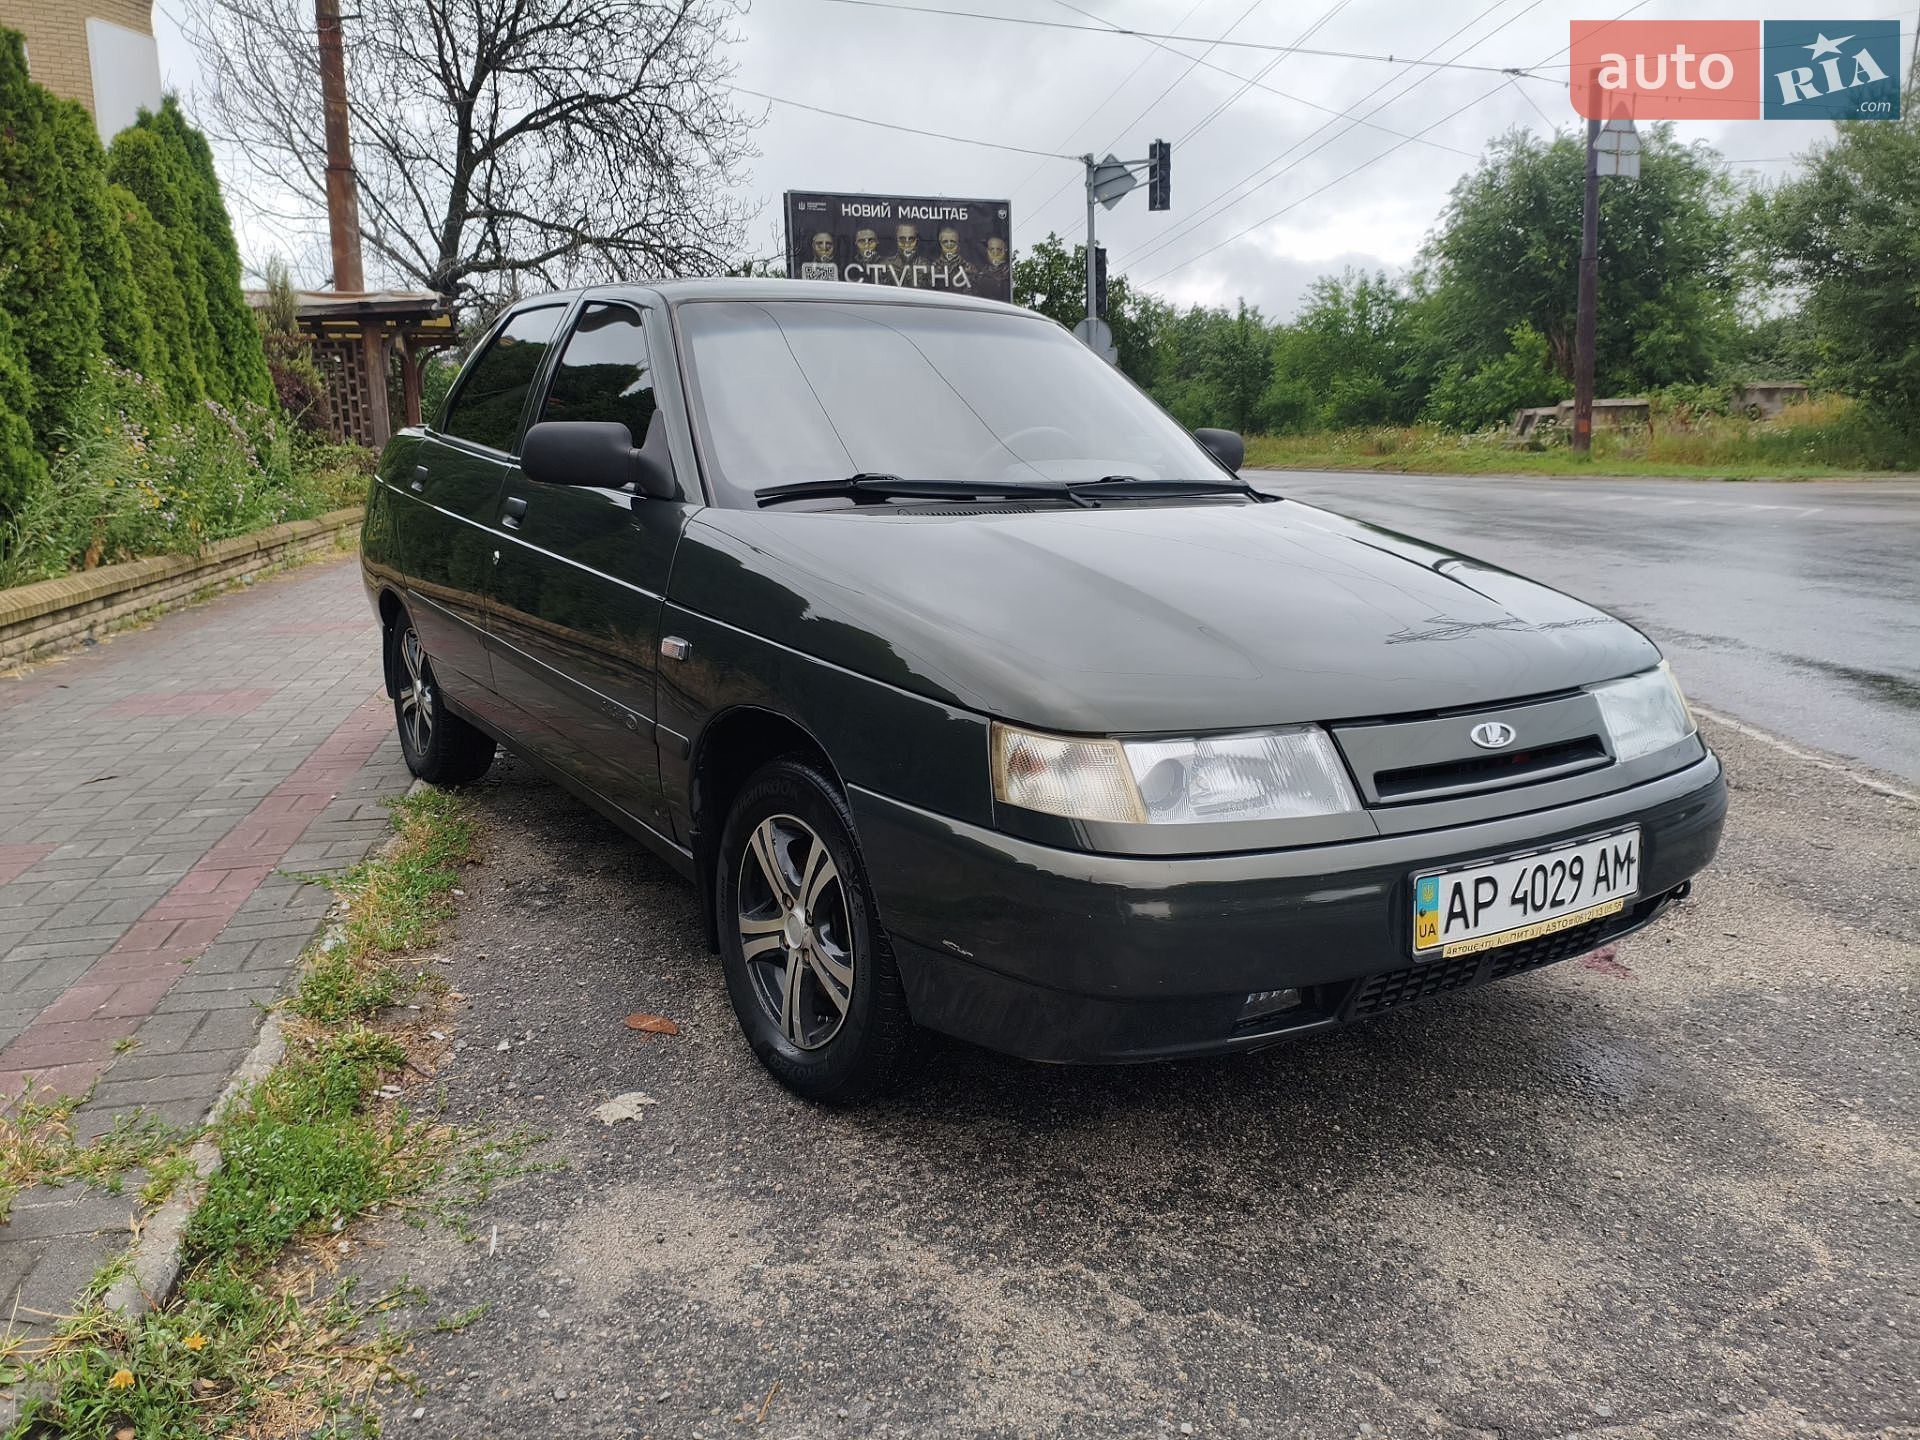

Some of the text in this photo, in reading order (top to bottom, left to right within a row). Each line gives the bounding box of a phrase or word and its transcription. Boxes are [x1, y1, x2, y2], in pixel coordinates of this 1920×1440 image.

[841, 202, 891, 218] НОВИЙ
[898, 206, 968, 221] МАСШТАБ
[1511, 855, 1585, 917] 4029
[1418, 923, 1437, 938] UA
